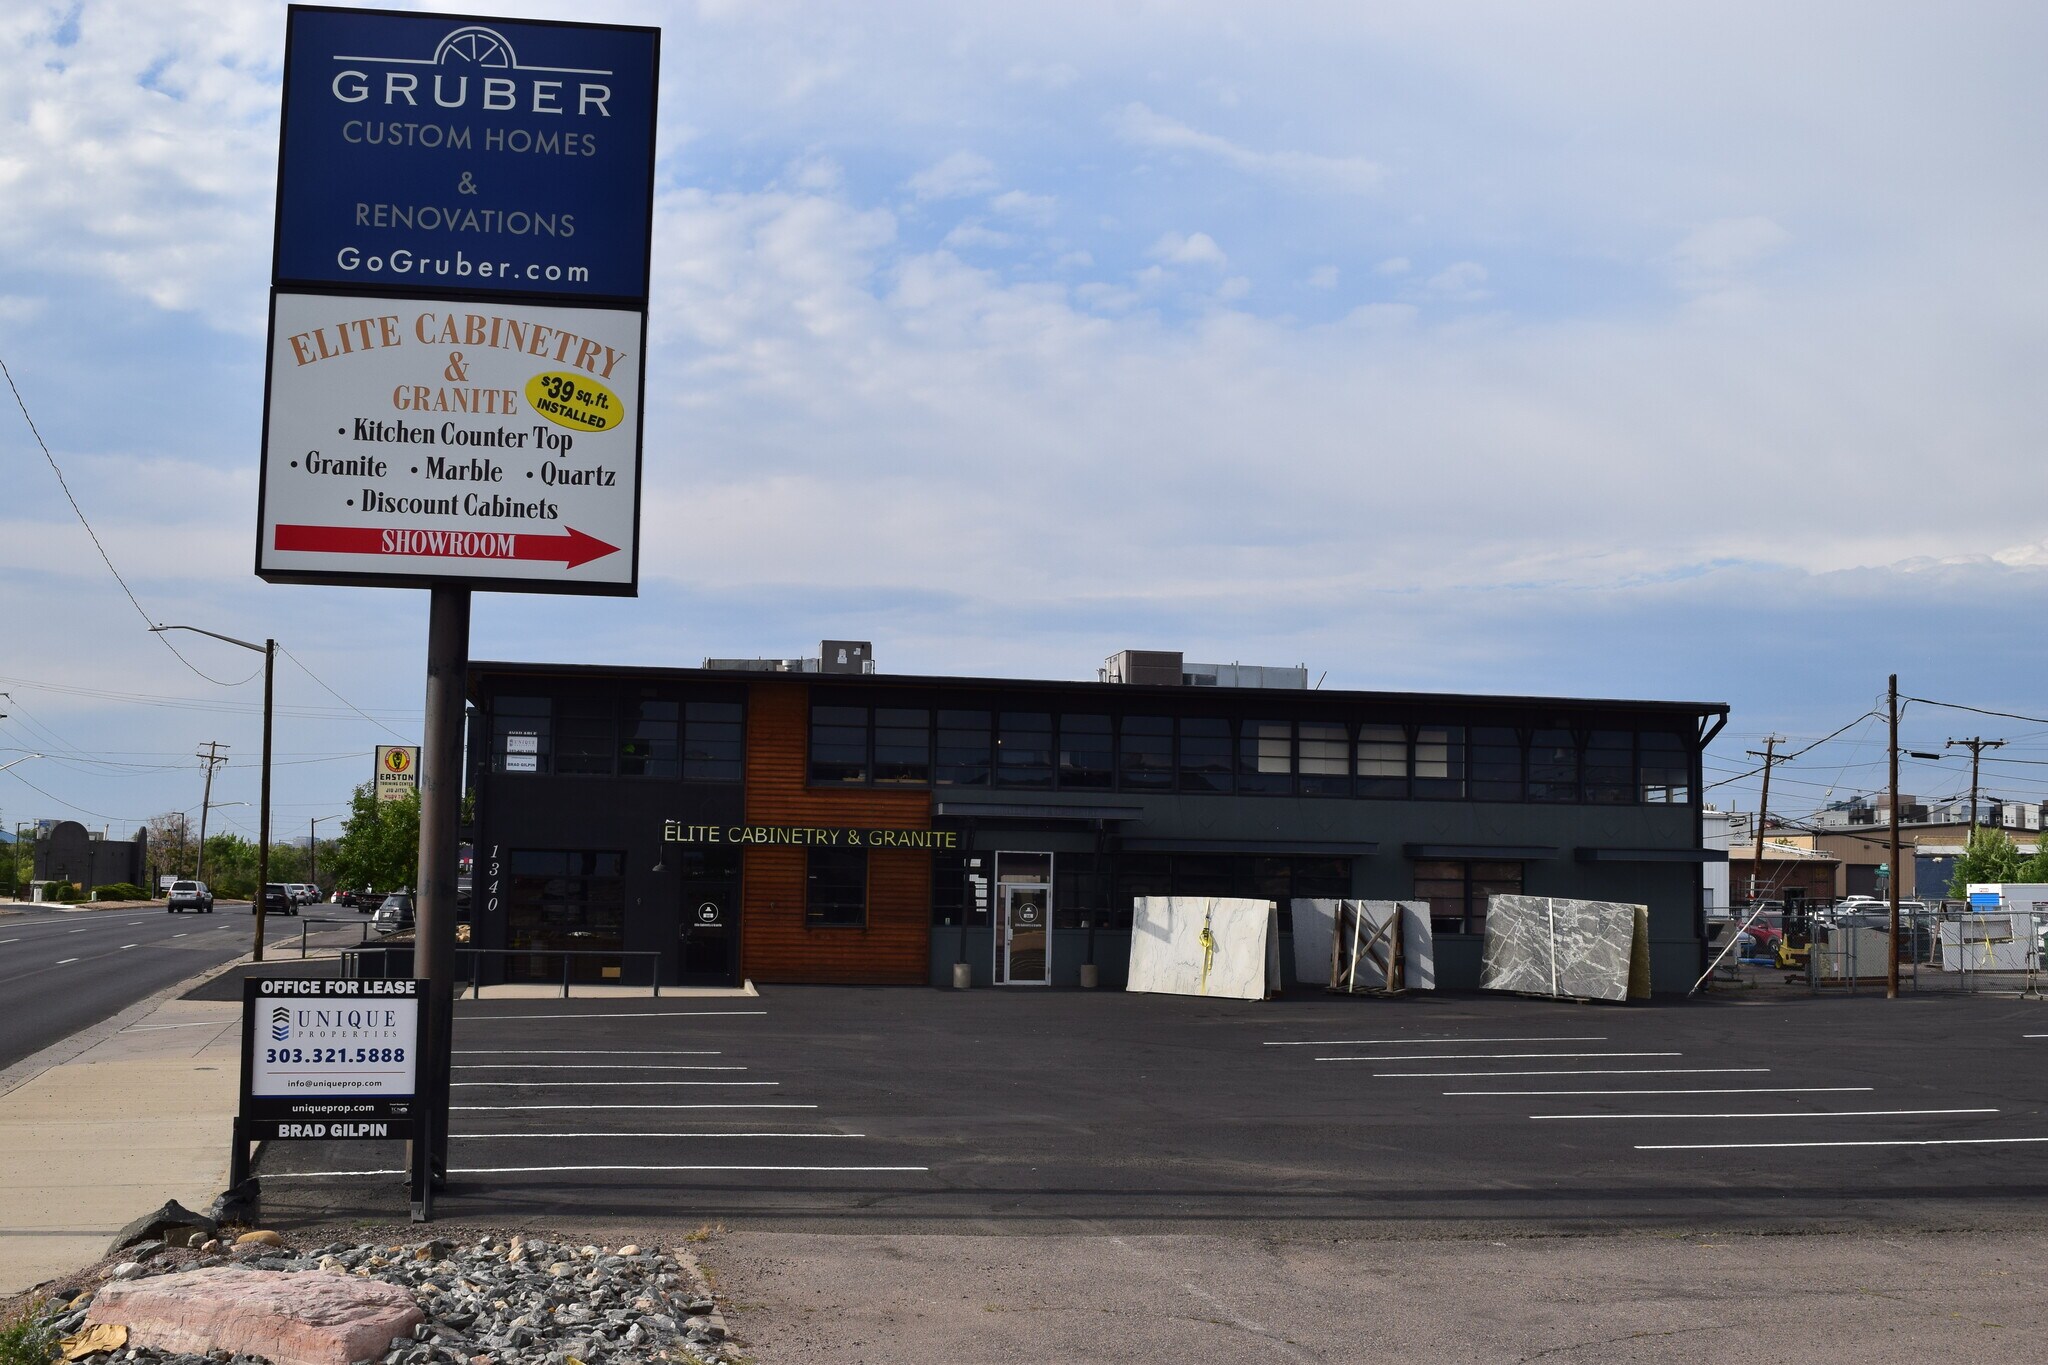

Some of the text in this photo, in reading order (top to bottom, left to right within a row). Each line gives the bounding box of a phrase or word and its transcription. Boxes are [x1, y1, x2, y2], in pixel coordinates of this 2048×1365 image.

[332, 70, 611, 117] GRUBER
[342, 120, 597, 157] CUSTOM HOMES
[457, 171, 478, 195] &
[356, 203, 575, 237] RENOVATIONS
[337, 246, 589, 282] GoGruber.com
[288, 313, 627, 380] ELITE CABINETRY
[444, 351, 469, 382] &
[393, 384, 518, 416] GRANITE
[541, 376, 575, 402] $39
[537, 397, 606, 429] INSTALLED
[353, 417, 573, 458] Kitchen Counter Top
[305, 451, 616, 487] Granite Marble Quartz
[361, 489, 559, 520] Discount Cabinets
[381, 529, 516, 558] SHOWROOM
[664, 825, 957, 848] ELITE CABINETRY & GRANITE
[261, 980, 416, 994] OFFICE FOR LEASE
[298, 1010, 396, 1029] UNIQUE
[298, 1030, 397, 1038] PROPERTIES
[266, 1048, 405, 1064] 303.321.5888
[288, 1080, 382, 1088] info@uniqueprop.com
[292, 1104, 374, 1114] uniqueprop.com
[278, 1124, 388, 1138] BRAD GILPIN
